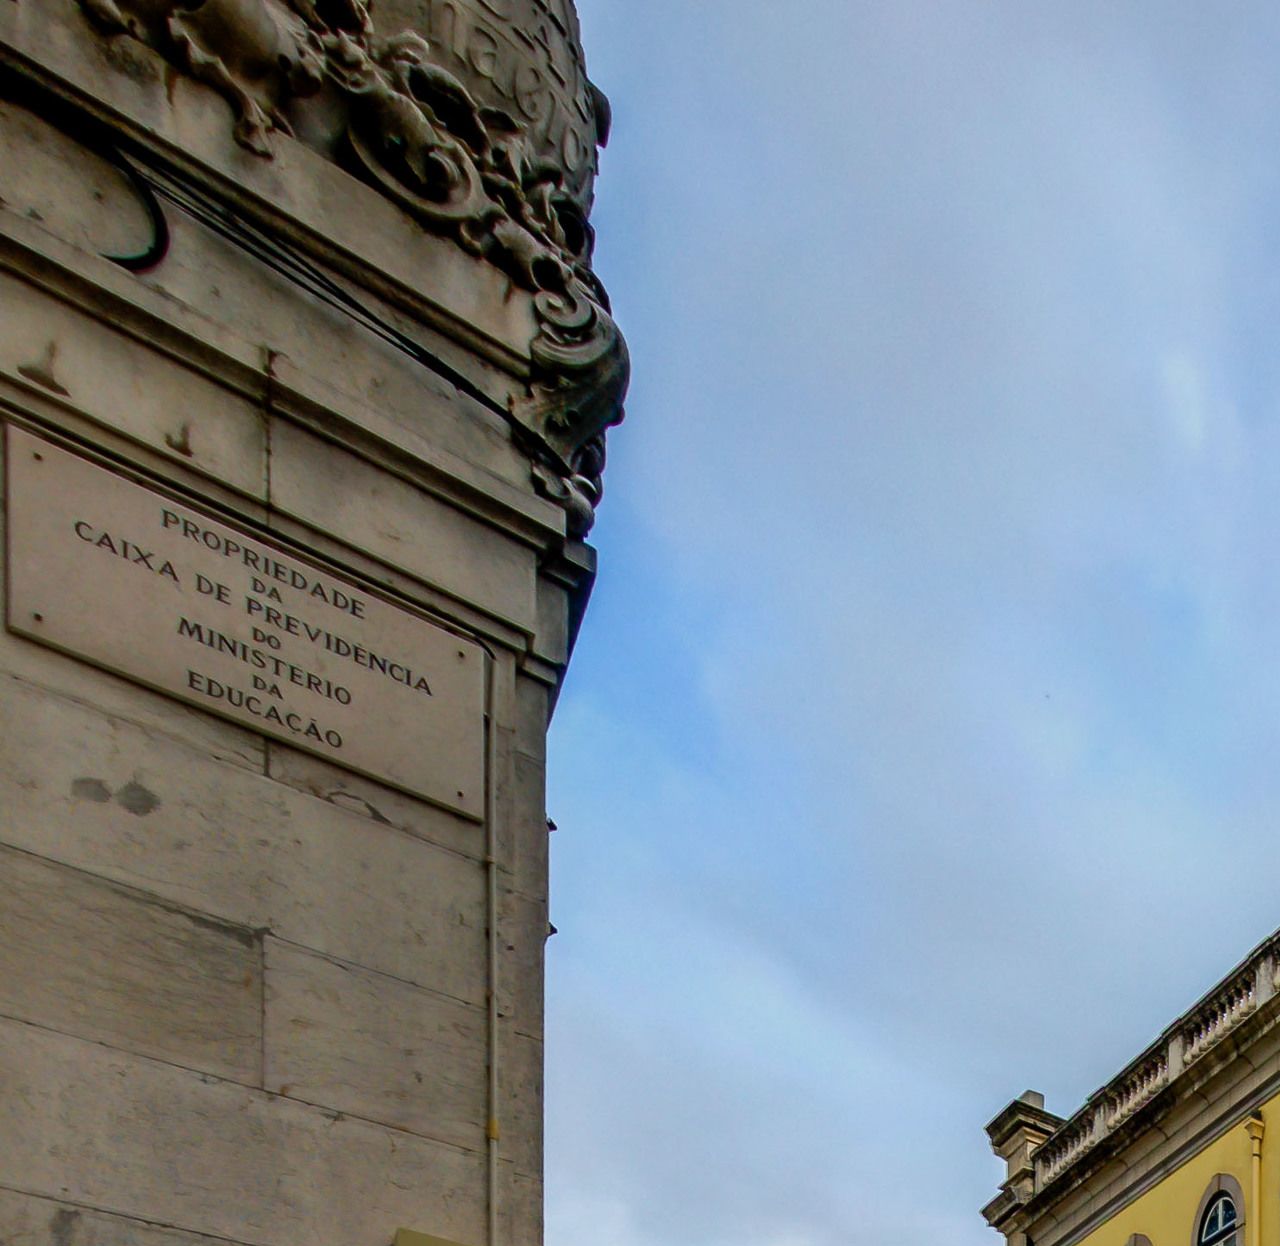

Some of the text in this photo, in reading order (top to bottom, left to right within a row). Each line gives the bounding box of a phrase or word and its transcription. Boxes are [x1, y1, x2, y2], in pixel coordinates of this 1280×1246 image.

[74, 520, 180, 583] CAIXA
[195, 573, 232, 606] DE
[162, 508, 366, 620] PROPRIEDADE
[251, 576, 283, 604] DA
[177, 616, 352, 706] MINISTERIO
[252, 626, 282, 650] DO
[187, 669, 343, 749] EDUCAÇÃO
[252, 674, 284, 701] DA
